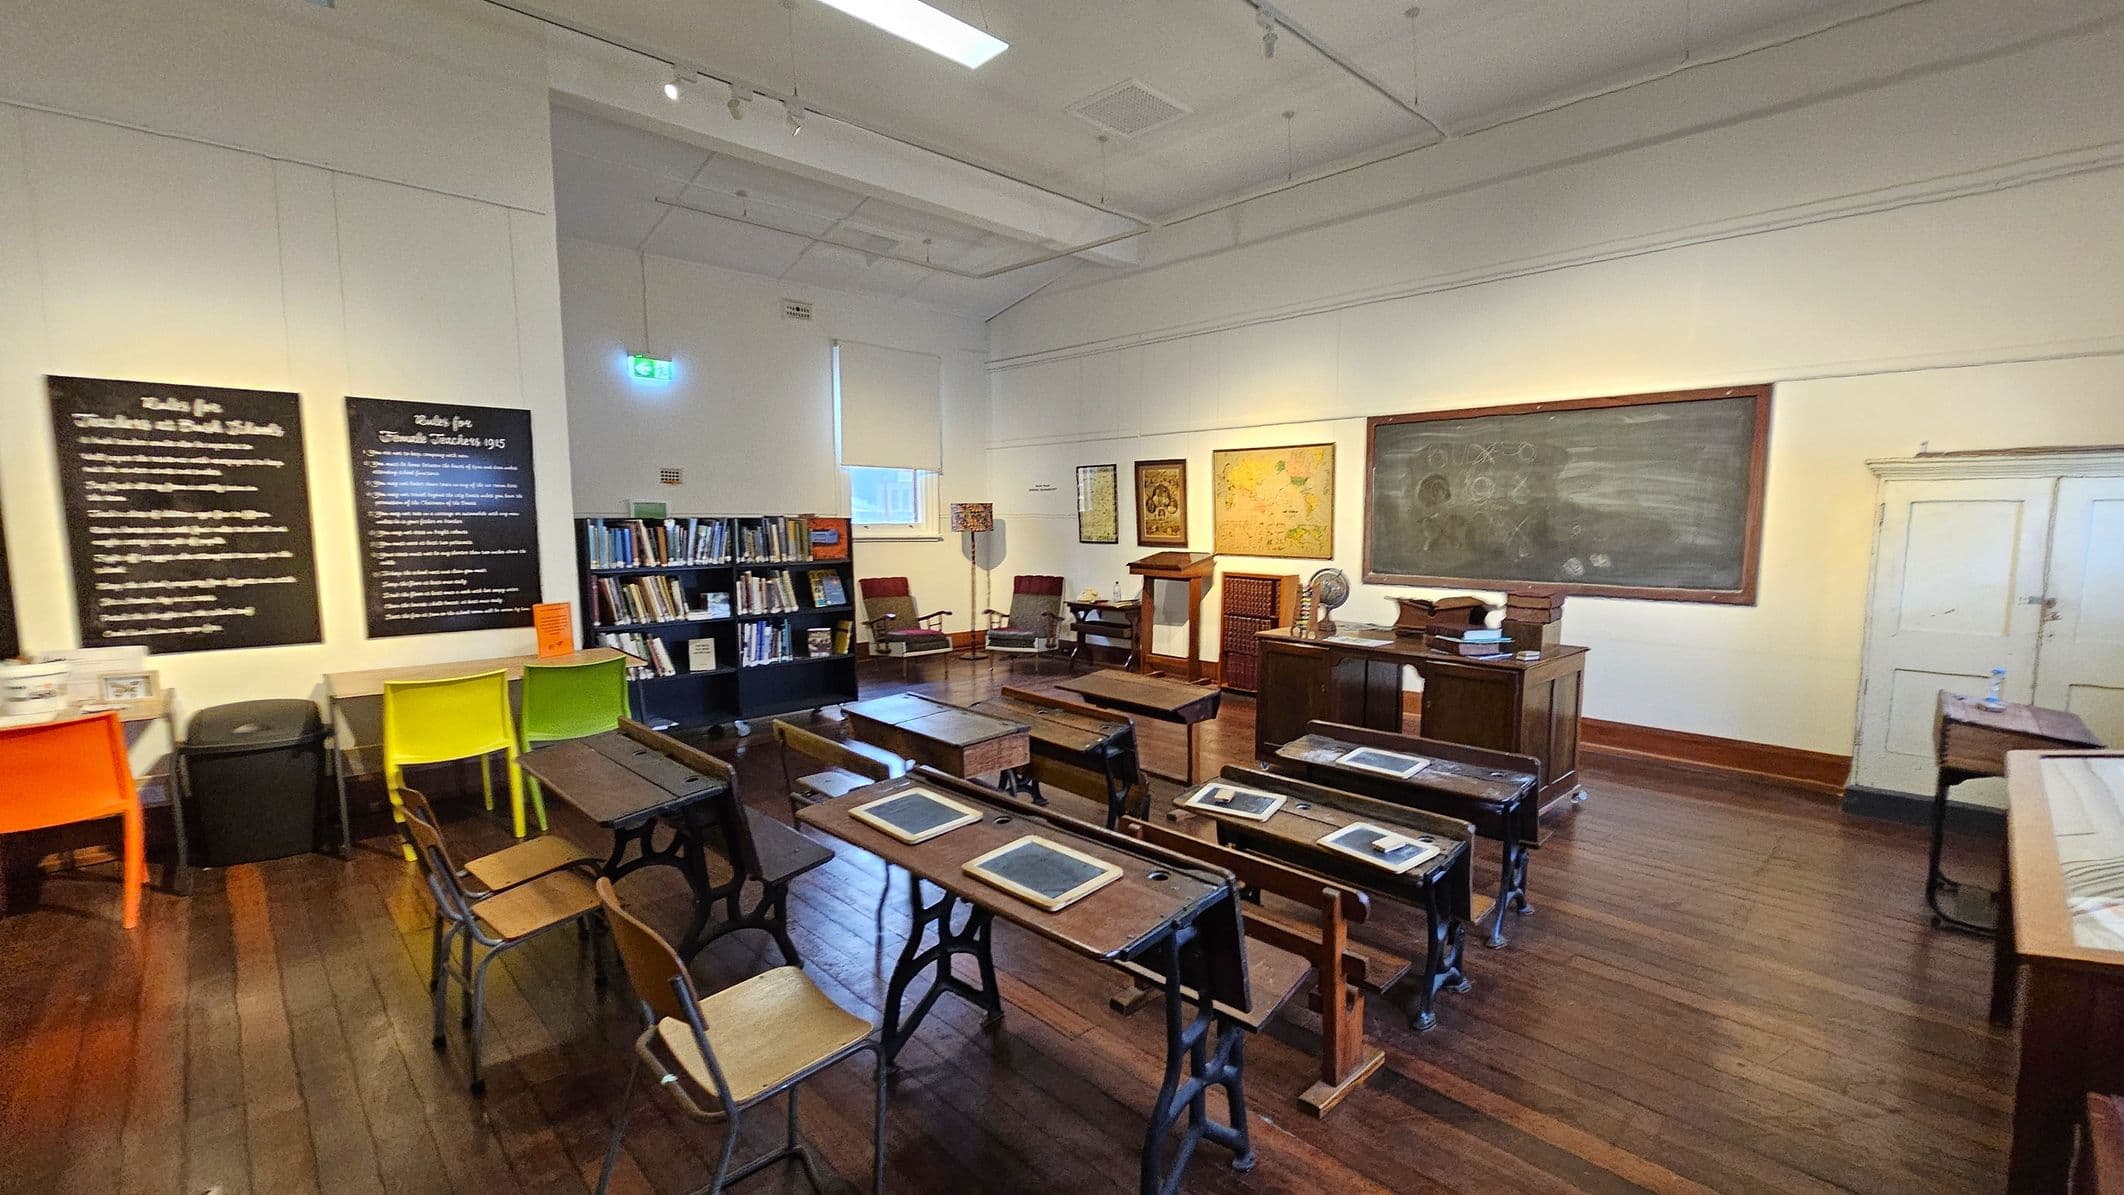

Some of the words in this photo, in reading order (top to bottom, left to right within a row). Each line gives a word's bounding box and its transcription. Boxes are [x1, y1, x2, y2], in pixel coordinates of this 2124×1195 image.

[413, 414, 450, 428] Rules
[452, 415, 473, 432] for
[379, 430, 428, 444] Female
[428, 433, 482, 447] Teachers
[483, 438, 506, 450] 1915
